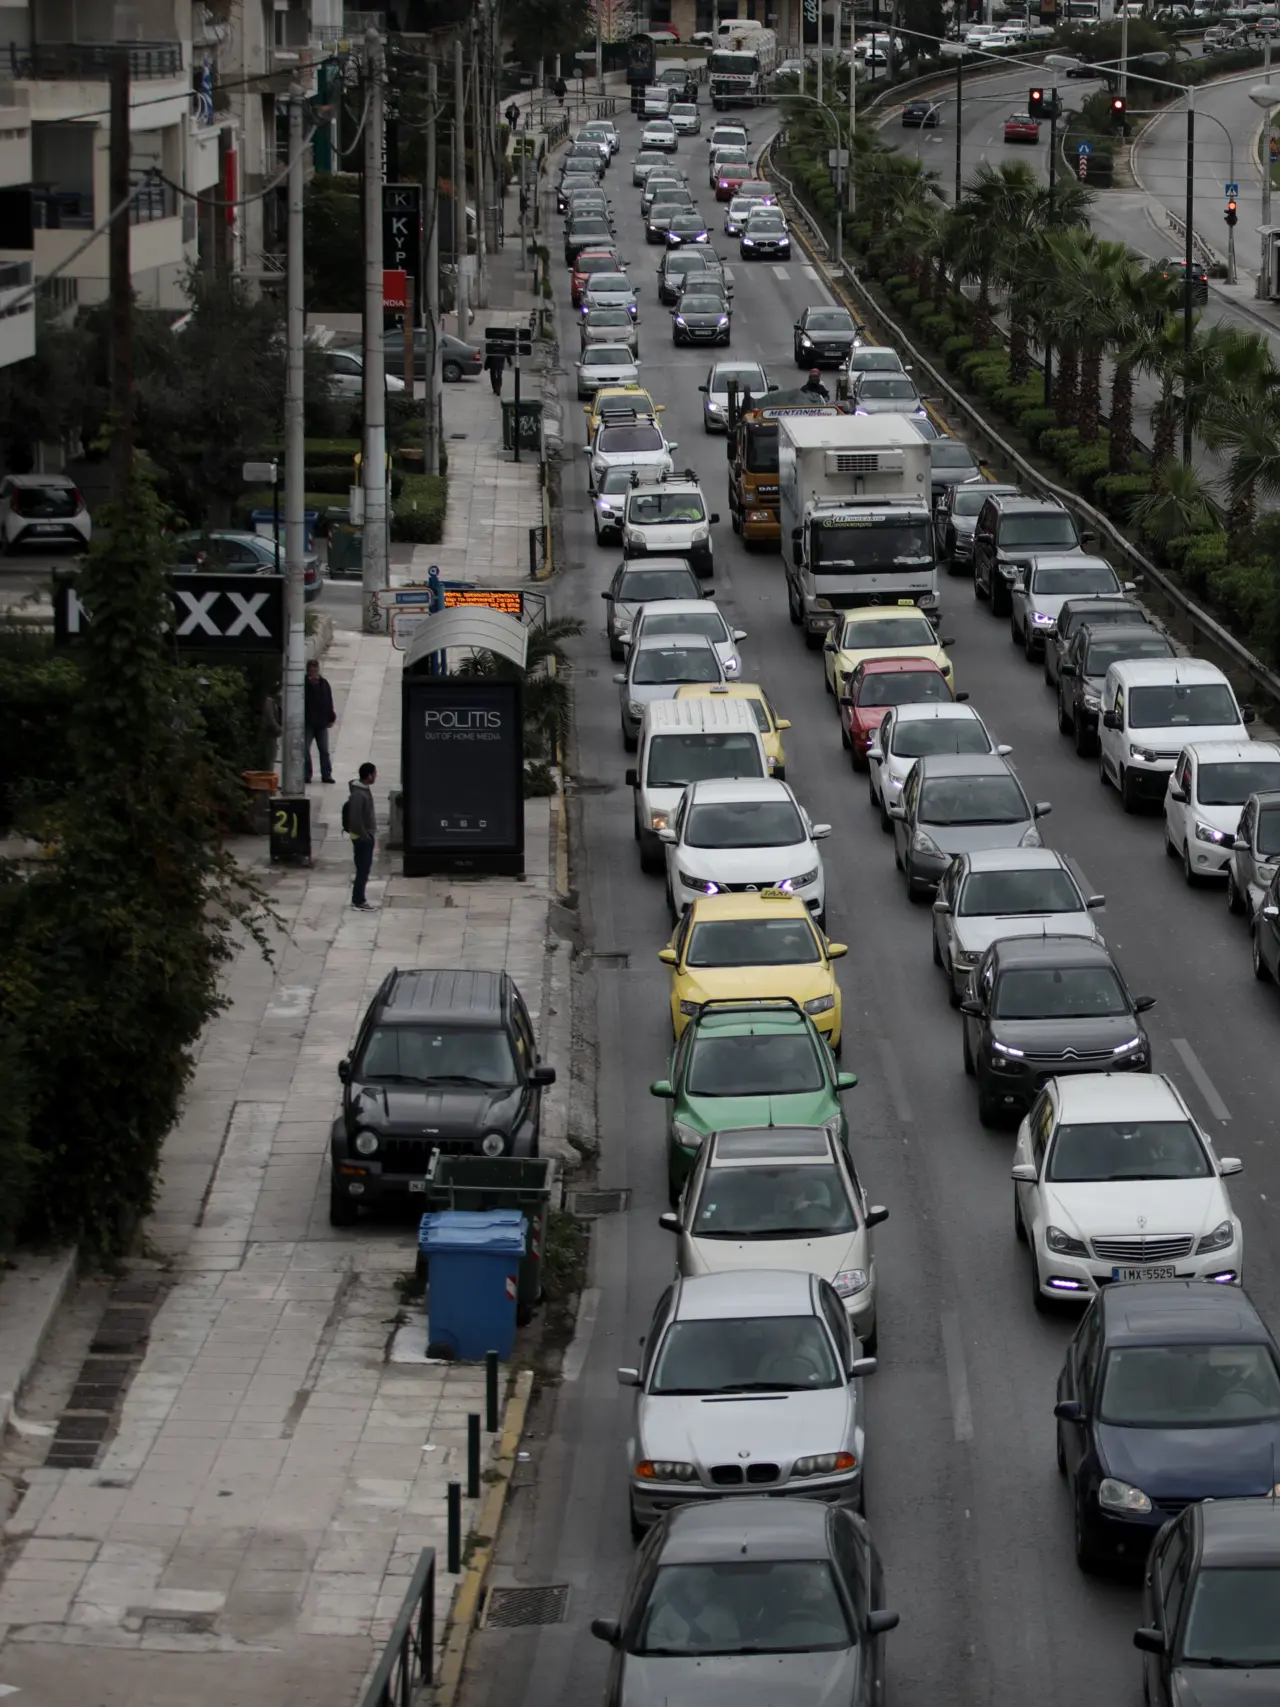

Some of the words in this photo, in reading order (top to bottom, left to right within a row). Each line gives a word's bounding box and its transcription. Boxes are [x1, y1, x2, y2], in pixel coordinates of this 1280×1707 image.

[424, 710, 502, 728] POLITIS
[425, 732, 442, 740] OUT
[442, 732, 452, 740] OF
[453, 732, 475, 740] HOME
[476, 732, 501, 740] MEDIA
